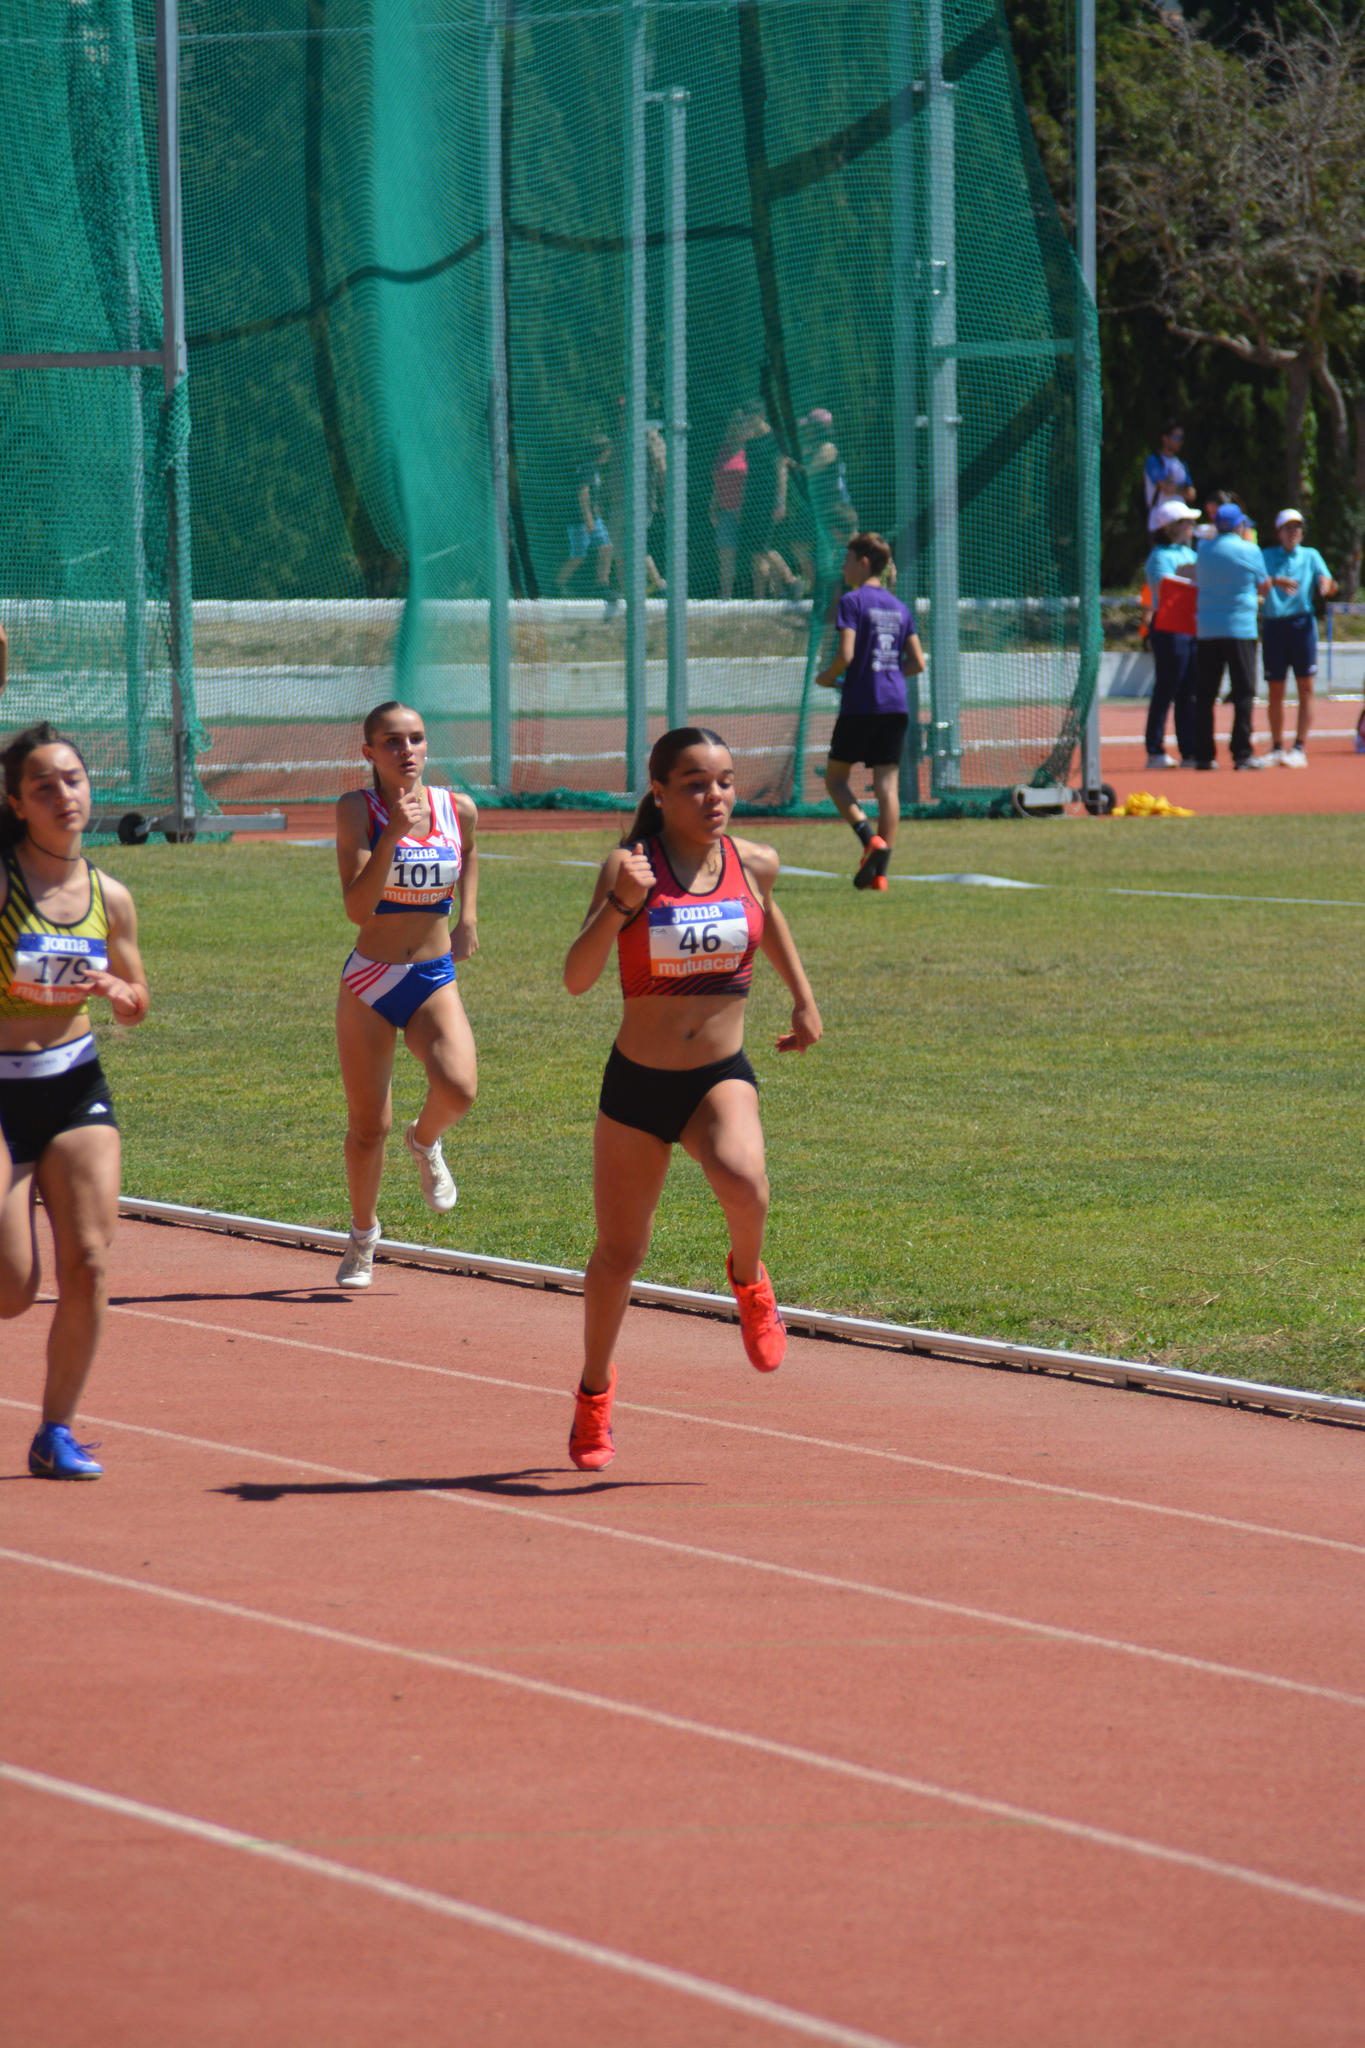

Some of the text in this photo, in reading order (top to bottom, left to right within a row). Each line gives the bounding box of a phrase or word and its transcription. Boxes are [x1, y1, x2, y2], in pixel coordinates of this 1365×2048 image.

[394, 863, 443, 888] 101
[672, 904, 723, 924] Joma
[41, 936, 91, 953] Joma
[679, 923, 721, 954] 46
[34, 956, 91, 985] 179
